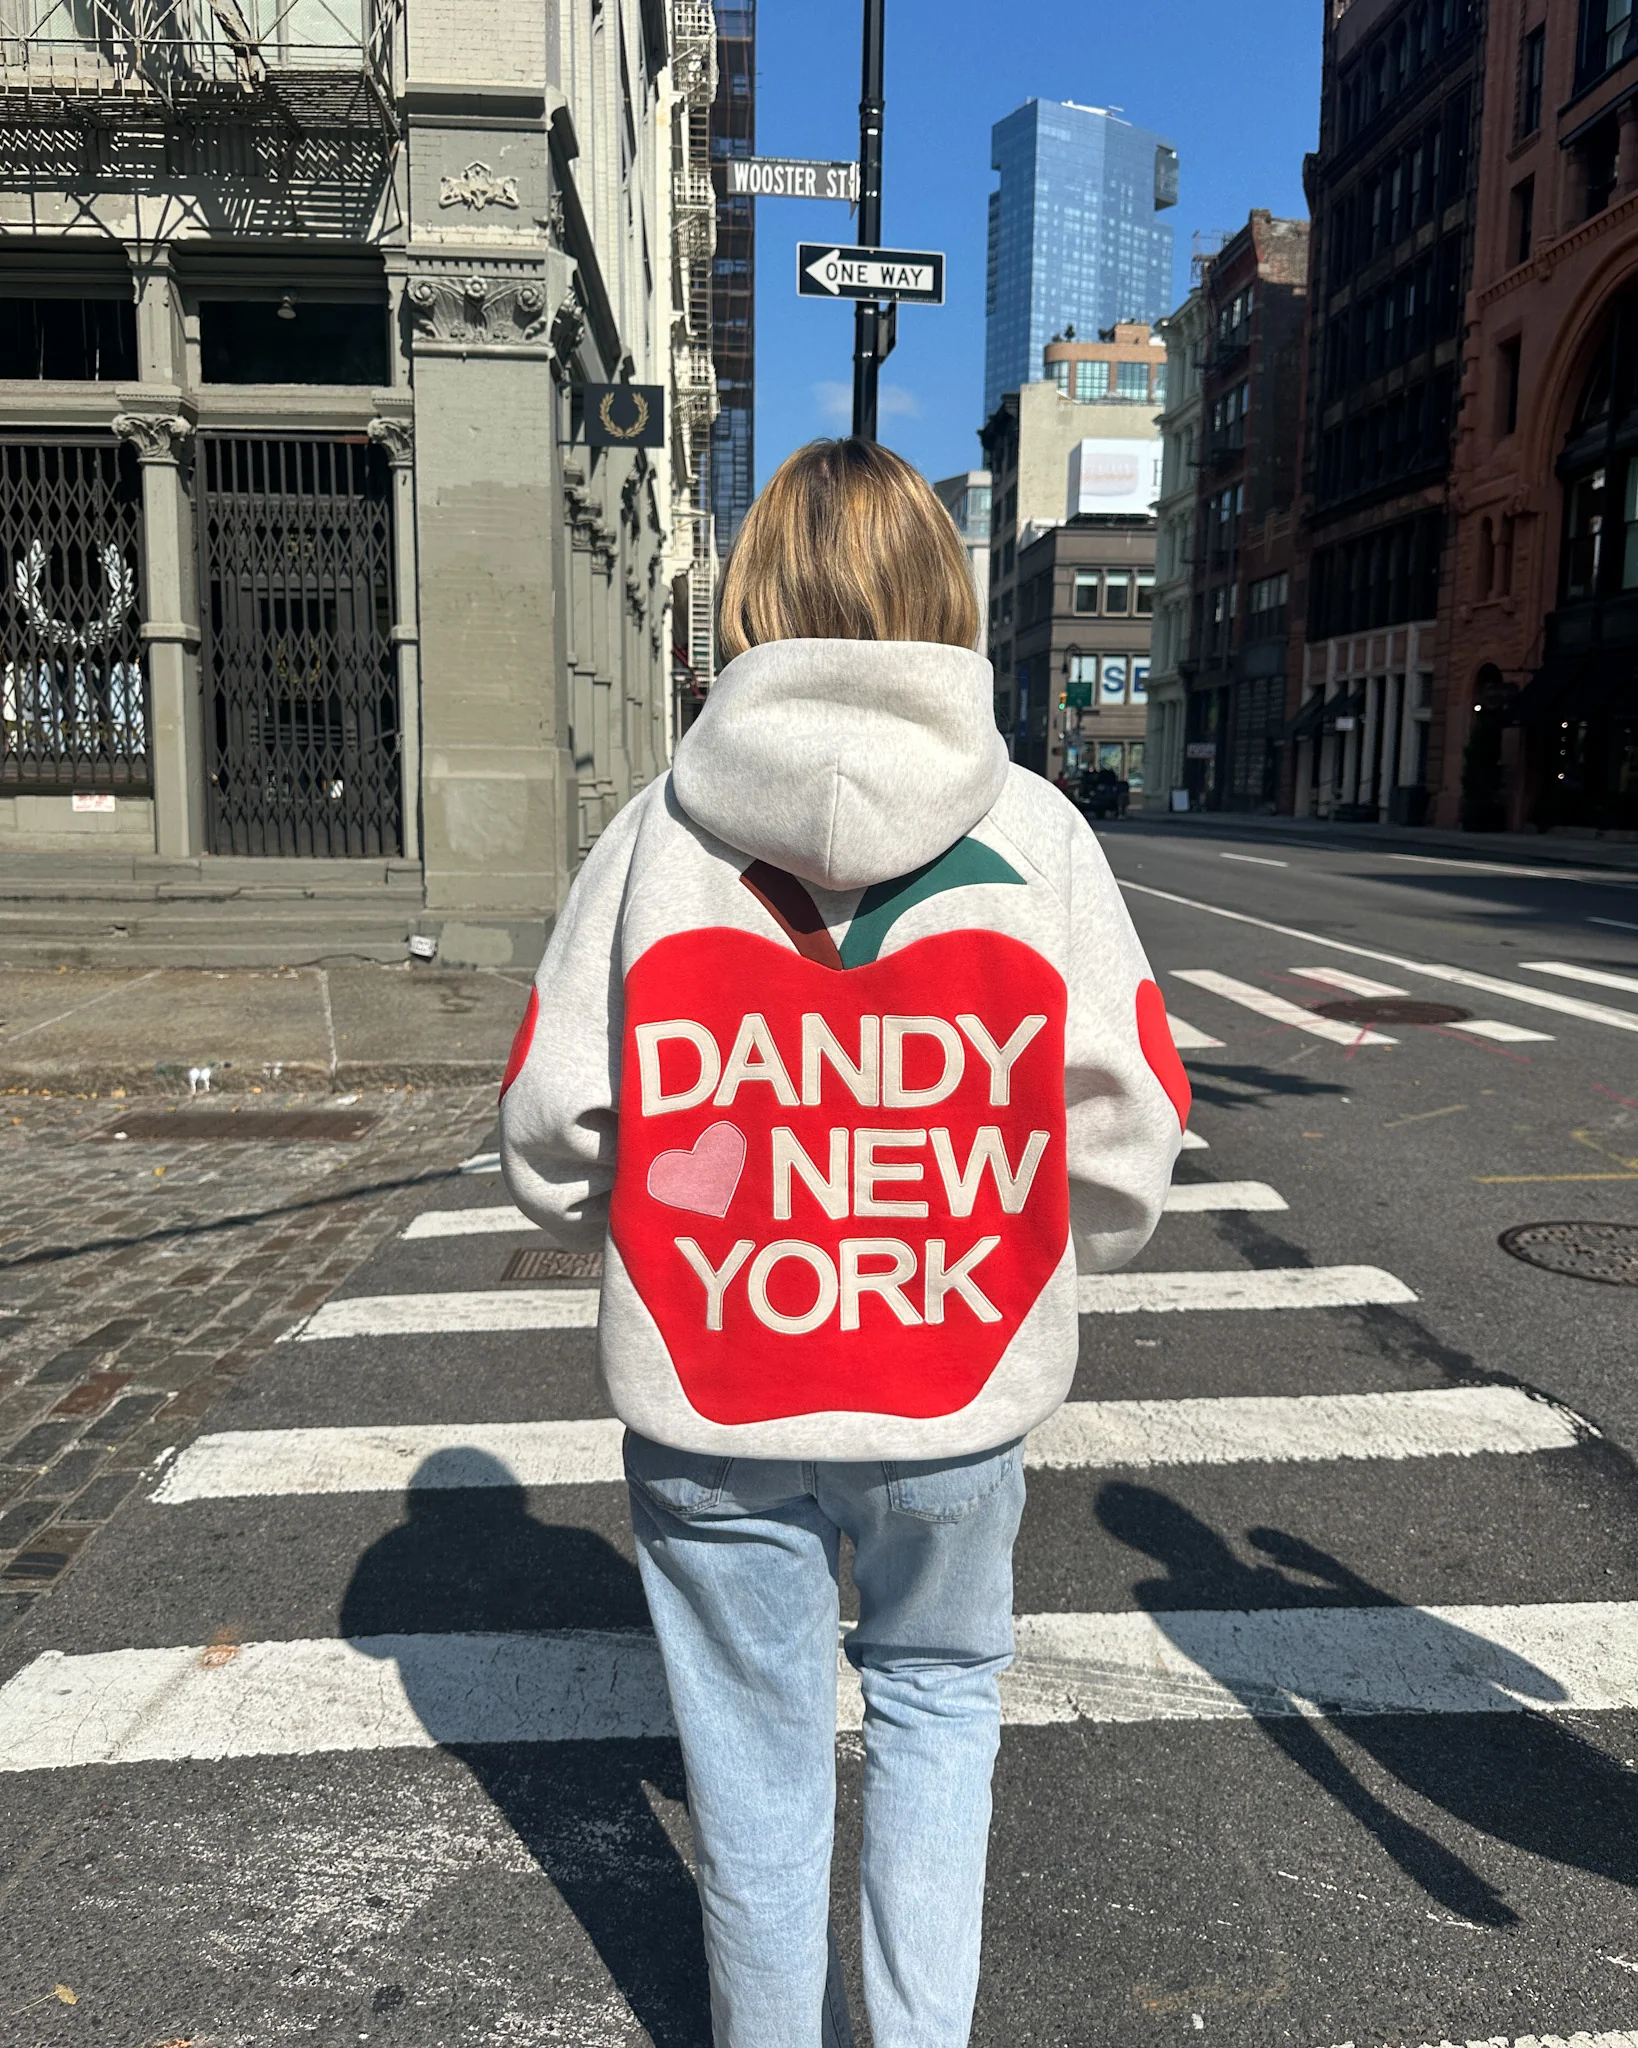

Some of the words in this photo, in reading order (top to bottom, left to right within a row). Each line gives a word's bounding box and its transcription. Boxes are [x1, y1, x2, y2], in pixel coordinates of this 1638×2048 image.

[734, 162, 817, 197] WOOSTER
[826, 169, 848, 199] ST
[825, 262, 868, 283] ONE
[881, 266, 923, 287] WAY
[635, 1012, 1048, 1117] DANDY
[771, 1126, 1050, 1219] NEW
[674, 1235, 1003, 1335] YORK
